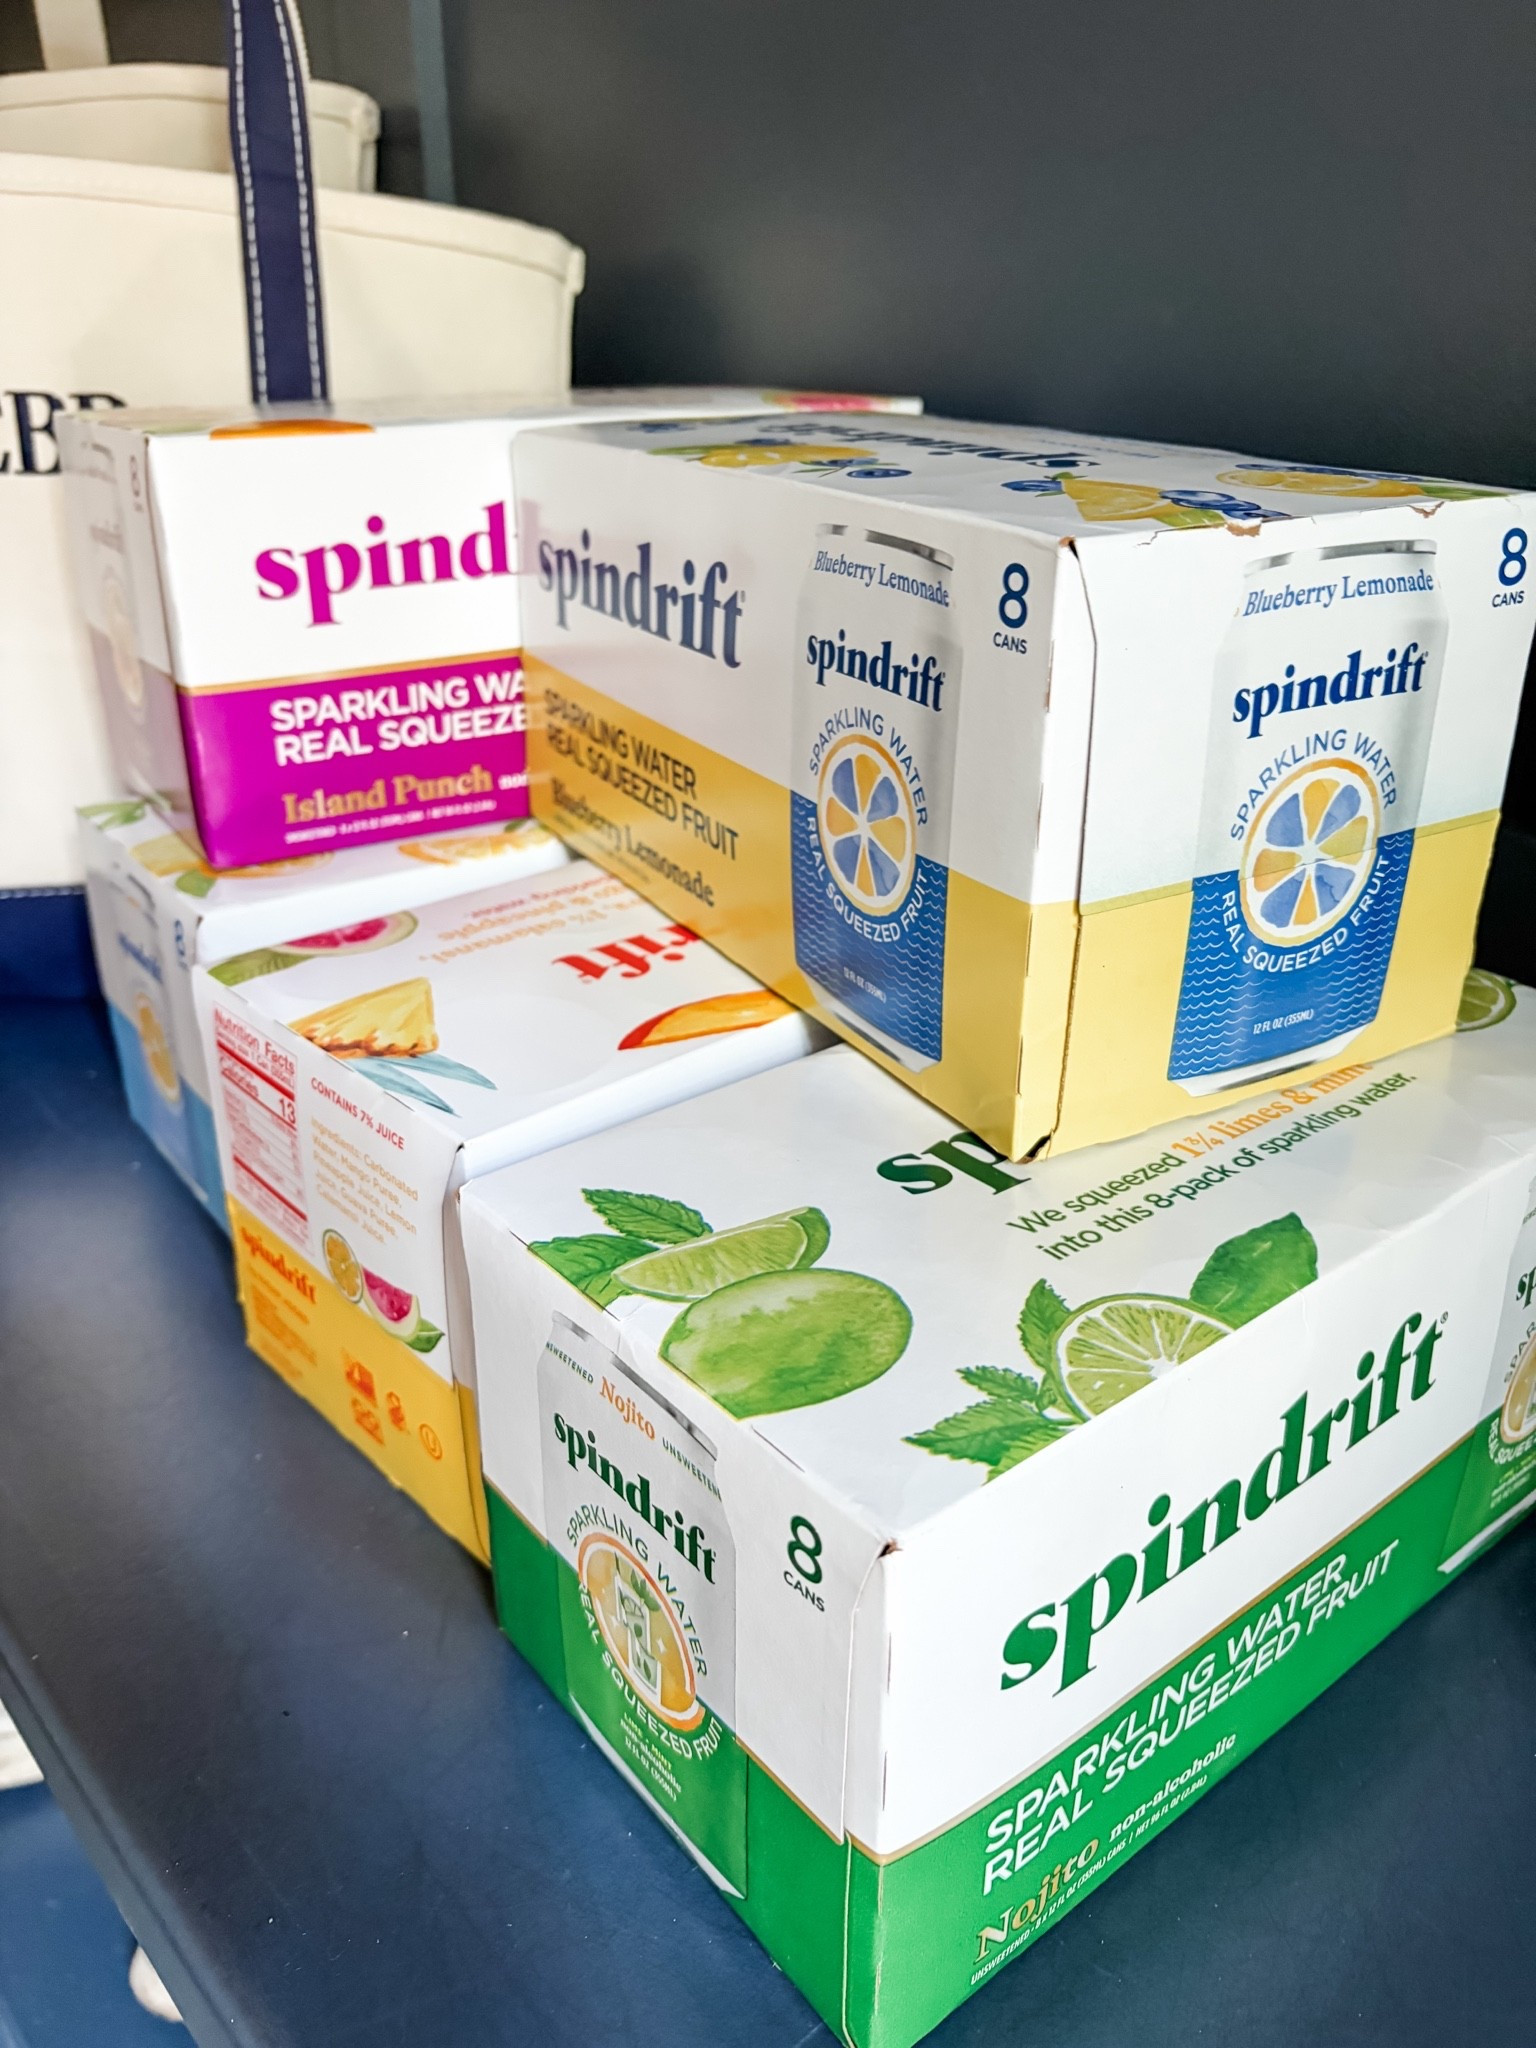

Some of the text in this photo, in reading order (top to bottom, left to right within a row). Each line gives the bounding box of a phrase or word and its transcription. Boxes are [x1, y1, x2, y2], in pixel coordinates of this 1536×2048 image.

[255, 500, 518, 628] spind
[539, 528, 744, 668] spindrift
[813, 551, 950, 608] Blueberry Lemonade
[999, 563, 1029, 628] 8
[1243, 568, 1434, 617] Blueberry Lemonade
[1491, 591, 1524, 608] CANS
[1498, 528, 1528, 586] 8
[806, 629, 945, 712] spindrift
[994, 632, 1027, 654] CANS
[270, 676, 470, 732] SPARKLING
[1232, 642, 1427, 739] spindrift
[274, 725, 373, 767] REAL
[545, 688, 697, 800] SPARKLING WATER
[809, 706, 928, 827] SPARKLING WATER
[1230, 729, 1397, 841] SPARKLING WATER
[283, 778, 387, 825] Island
[392, 764, 492, 806] Punch
[547, 723, 584, 767] REAL
[587, 746, 678, 822] SQUEEZED
[681, 802, 738, 861] FRUIT
[624, 822, 715, 907] Lemonade
[806, 816, 928, 943] REAL SQUEEZED FRUIT
[1221, 854, 1390, 974] REAL SQUEEZED FRUIT
[214, 1008, 261, 1049] Nutrition
[265, 1041, 295, 1075] Facts
[1253, 1008, 1315, 1035] 12 FL OZ (355ML)
[279, 1098, 297, 1124] 13
[311, 1077, 405, 1151] CONTAINS 7% JUICE
[363, 1154, 418, 1201] Carbonated
[1006, 1207, 1065, 1236] We
[1066, 1152, 1187, 1215] squeezed
[1219, 1099, 1293, 1141] limes
[1280, 1087, 1319, 1105] &
[1036, 1072, 1418, 1262] into this 8-pack of sparkling water.
[385, 1204, 417, 1236] Lemon
[599, 1376, 655, 1441] Nojito
[553, 1412, 716, 1585] spindrift
[1000, 1312, 1443, 1697] spindrift
[566, 1503, 708, 1677] SPARKLING WATER
[783, 1570, 826, 1613] CANS
[787, 1515, 823, 1585] 8
[577, 1578, 724, 1762] REAL SQUEEZED FRUIT
[985, 1553, 1347, 1854] SPARKLING WATER
[982, 1539, 1400, 1896] REAL SQUEEZED FRUIT
[973, 1733, 1237, 1964] Nojito non-alcoholic
[970, 1928, 1030, 1986] UNSWEETENED
[1106, 1837, 1127, 1862] CANS
[1135, 1819, 1151, 1838] NET
